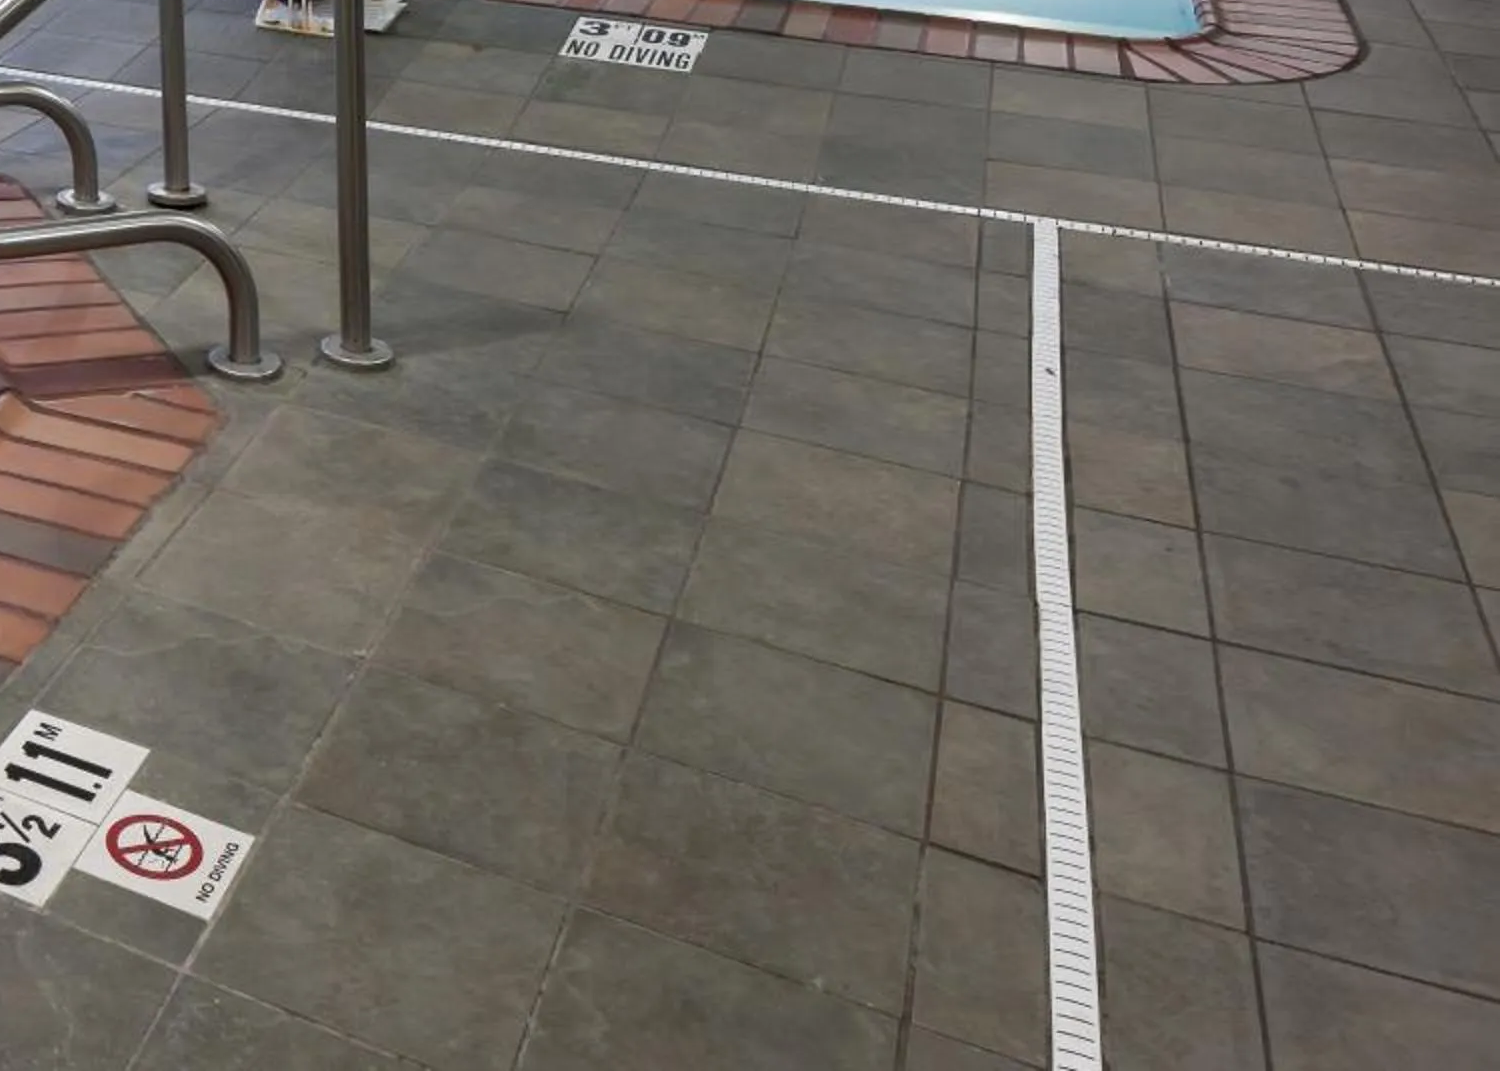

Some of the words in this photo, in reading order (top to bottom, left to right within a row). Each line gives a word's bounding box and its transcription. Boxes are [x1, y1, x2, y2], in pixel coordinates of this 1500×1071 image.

[579, 20, 611, 36] 3
[566, 40, 601, 57] NO
[609, 44, 691, 70] DIVING
[33, 722, 62, 741] M
[195, 882, 216, 902] NO
[210, 841, 240, 882] DIVING
